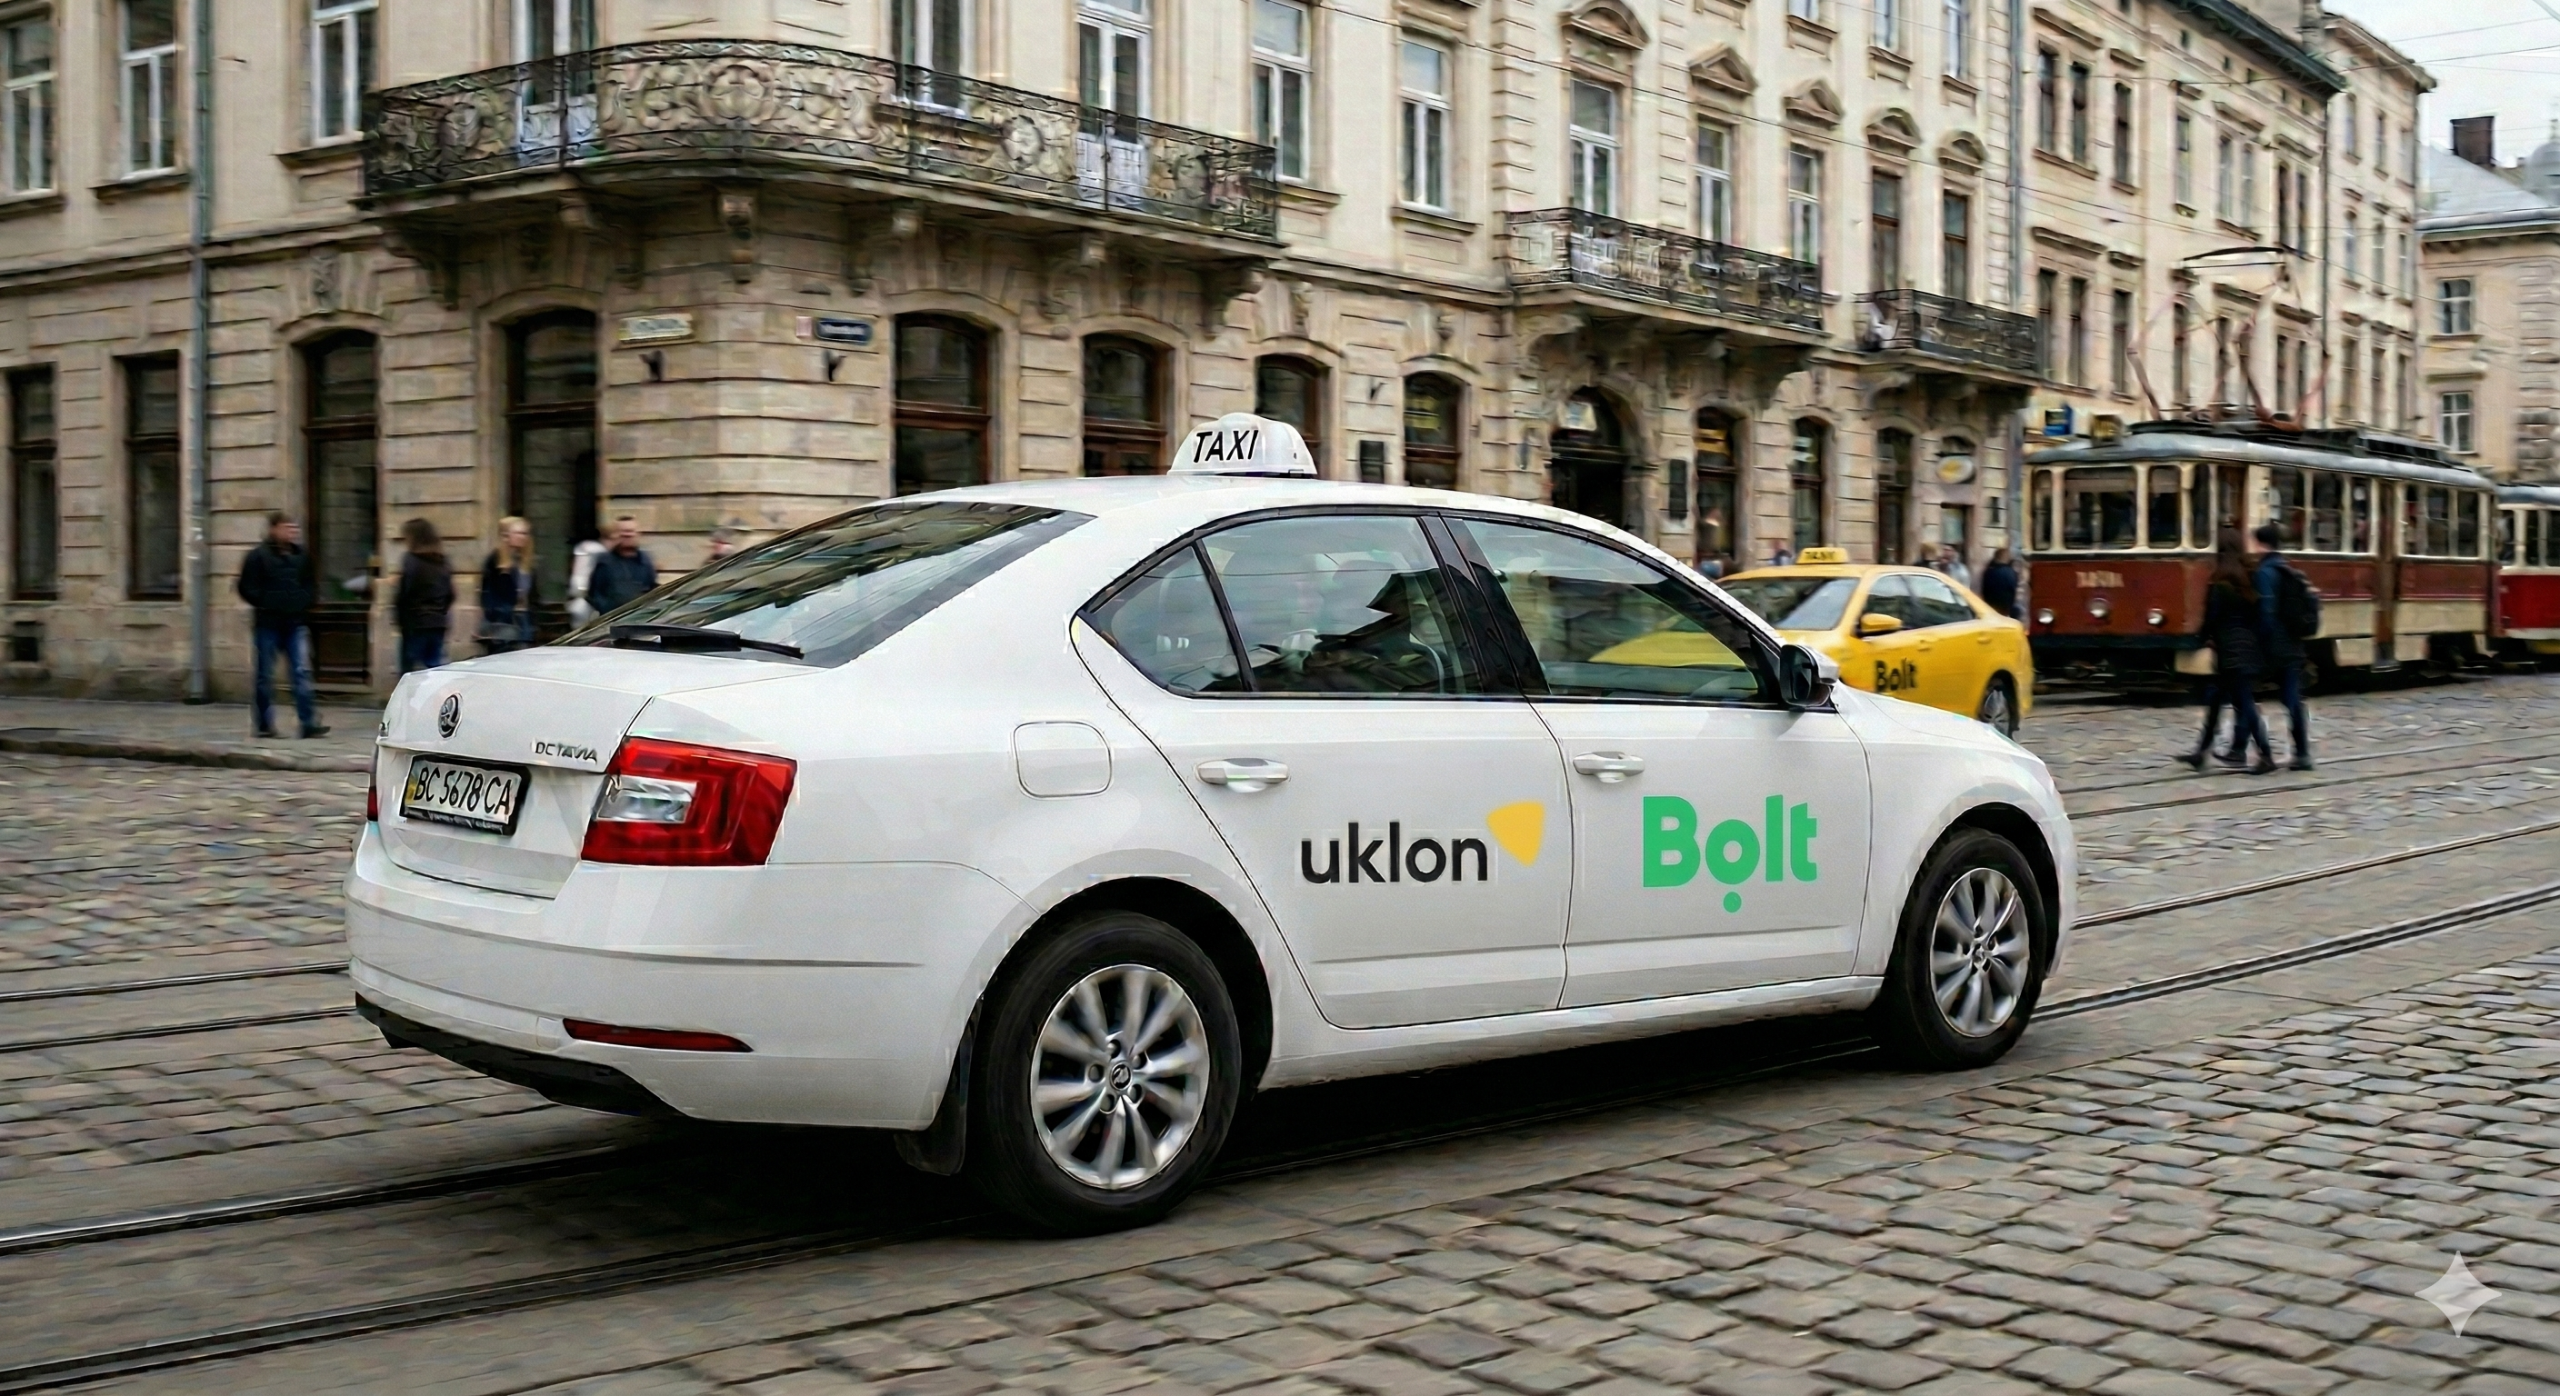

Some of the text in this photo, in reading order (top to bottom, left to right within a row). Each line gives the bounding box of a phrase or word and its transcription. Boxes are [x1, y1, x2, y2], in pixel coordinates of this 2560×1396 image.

[1193, 429, 1259, 463] TAXI
[1875, 658, 1917, 694] Bolt
[413, 766, 513, 815] BC 5678 CA
[1300, 820, 1488, 884] uklon
[1643, 795, 1817, 913] Bolt
